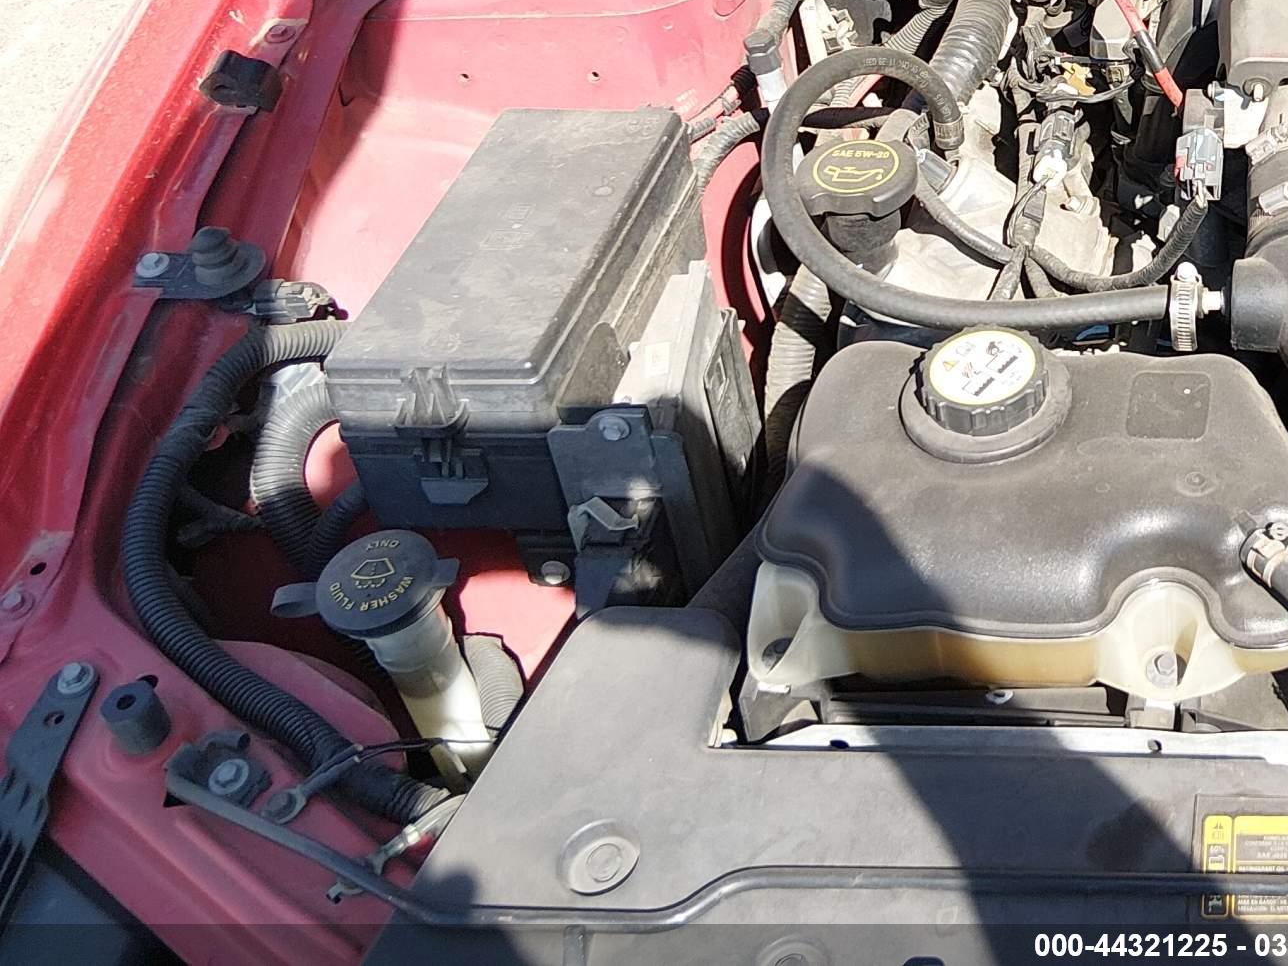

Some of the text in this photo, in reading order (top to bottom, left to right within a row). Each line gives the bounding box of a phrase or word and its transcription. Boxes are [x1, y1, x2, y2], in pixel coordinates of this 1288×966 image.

[831, 149, 890, 159] SAE 5W-20
[365, 538, 401, 552] ONLY
[329, 576, 415, 612] WASHER FLUID
